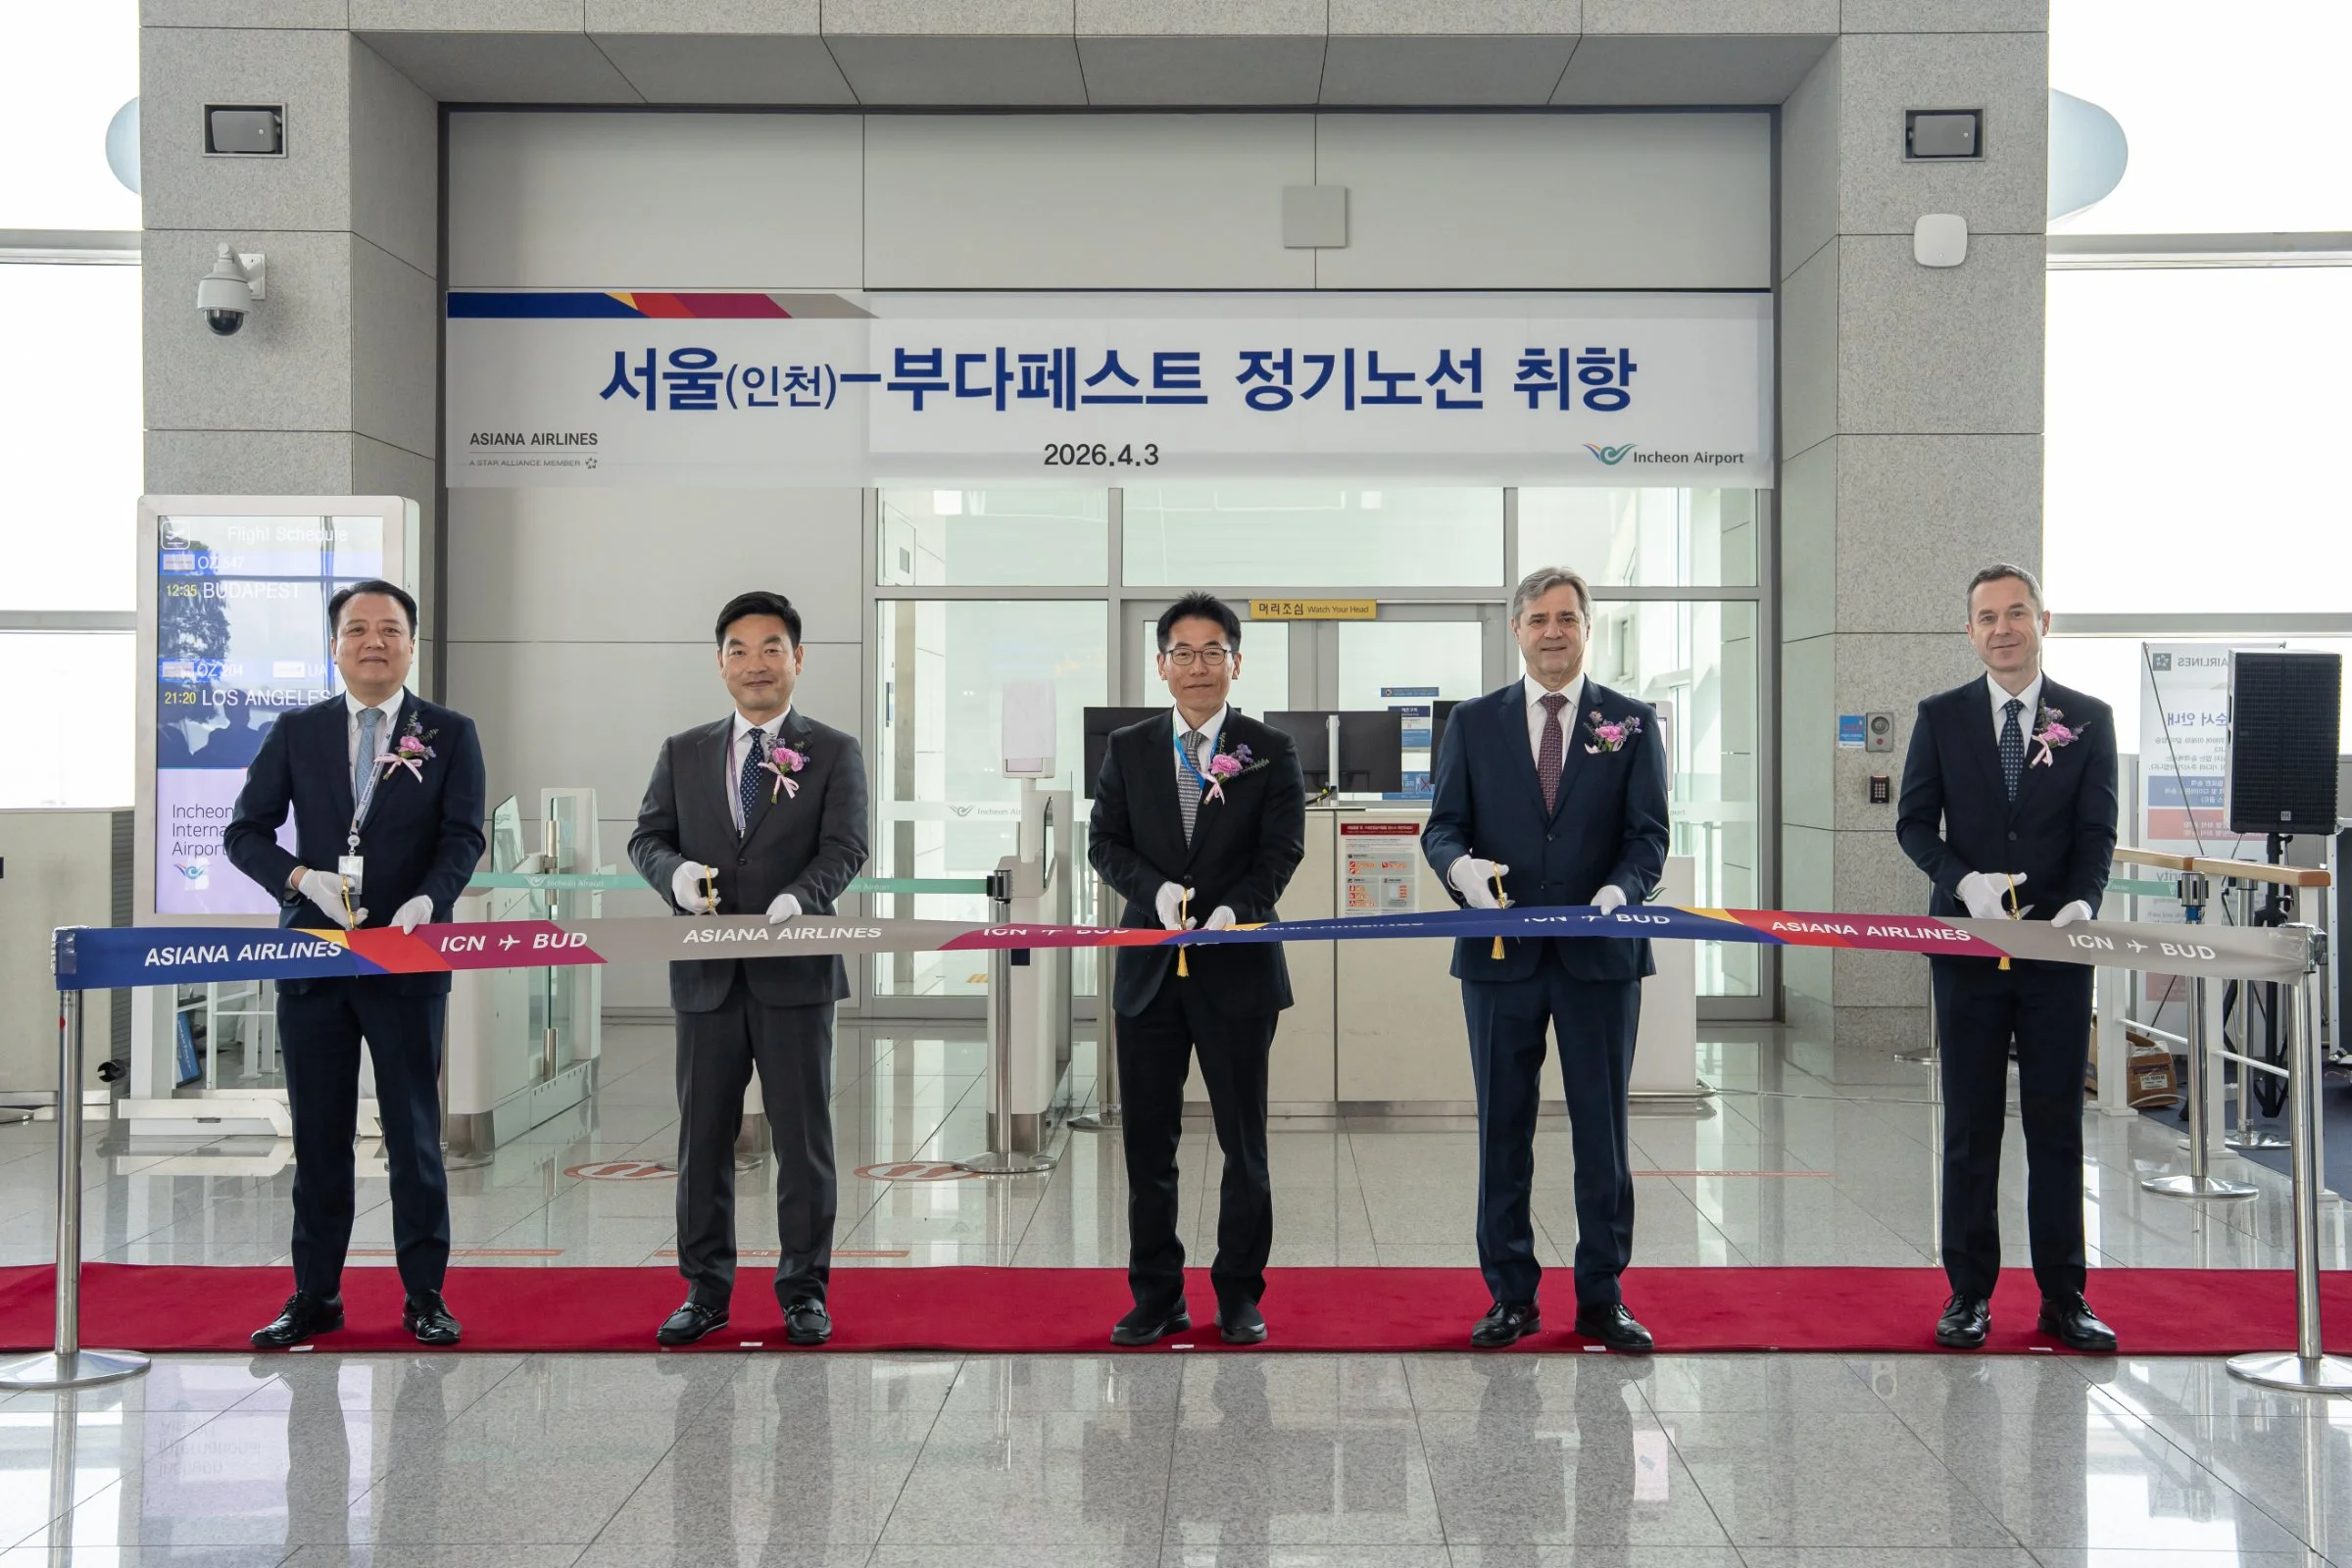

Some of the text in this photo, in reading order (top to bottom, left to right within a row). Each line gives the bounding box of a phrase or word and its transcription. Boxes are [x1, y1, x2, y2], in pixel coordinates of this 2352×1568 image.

[1236, 346, 1485, 412] 정기노선
[1514, 346, 1638, 412] 취항
[469, 432, 598, 446] ASIANA AIRLINES
[1044, 443, 1159, 466] 2026.4.3
[1633, 451, 1744, 466] Incheon Airport
[227, 525, 348, 543] Flight Schedule
[198, 556, 219, 569] OZ
[166, 584, 198, 597] 12:35
[203, 582, 301, 599] BUDAPEST
[1258, 603, 1304, 615] 머리조심
[197, 662, 218, 678] OZ
[165, 692, 197, 705] 21:20
[202, 689, 331, 707] LOS ANGELES
[172, 804, 234, 819] Incheon
[172, 822, 225, 837] Interna
[172, 841, 226, 858] Airport
[1617, 914, 1671, 924] BUD
[683, 926, 882, 944] ASIANA AIRLINES
[1772, 921, 1972, 942] ASIANA AIRLINES
[440, 932, 588, 954] ICN BUD
[2068, 934, 2217, 959] ICN BUD
[144, 941, 342, 966] ASIANA AIRLINES
